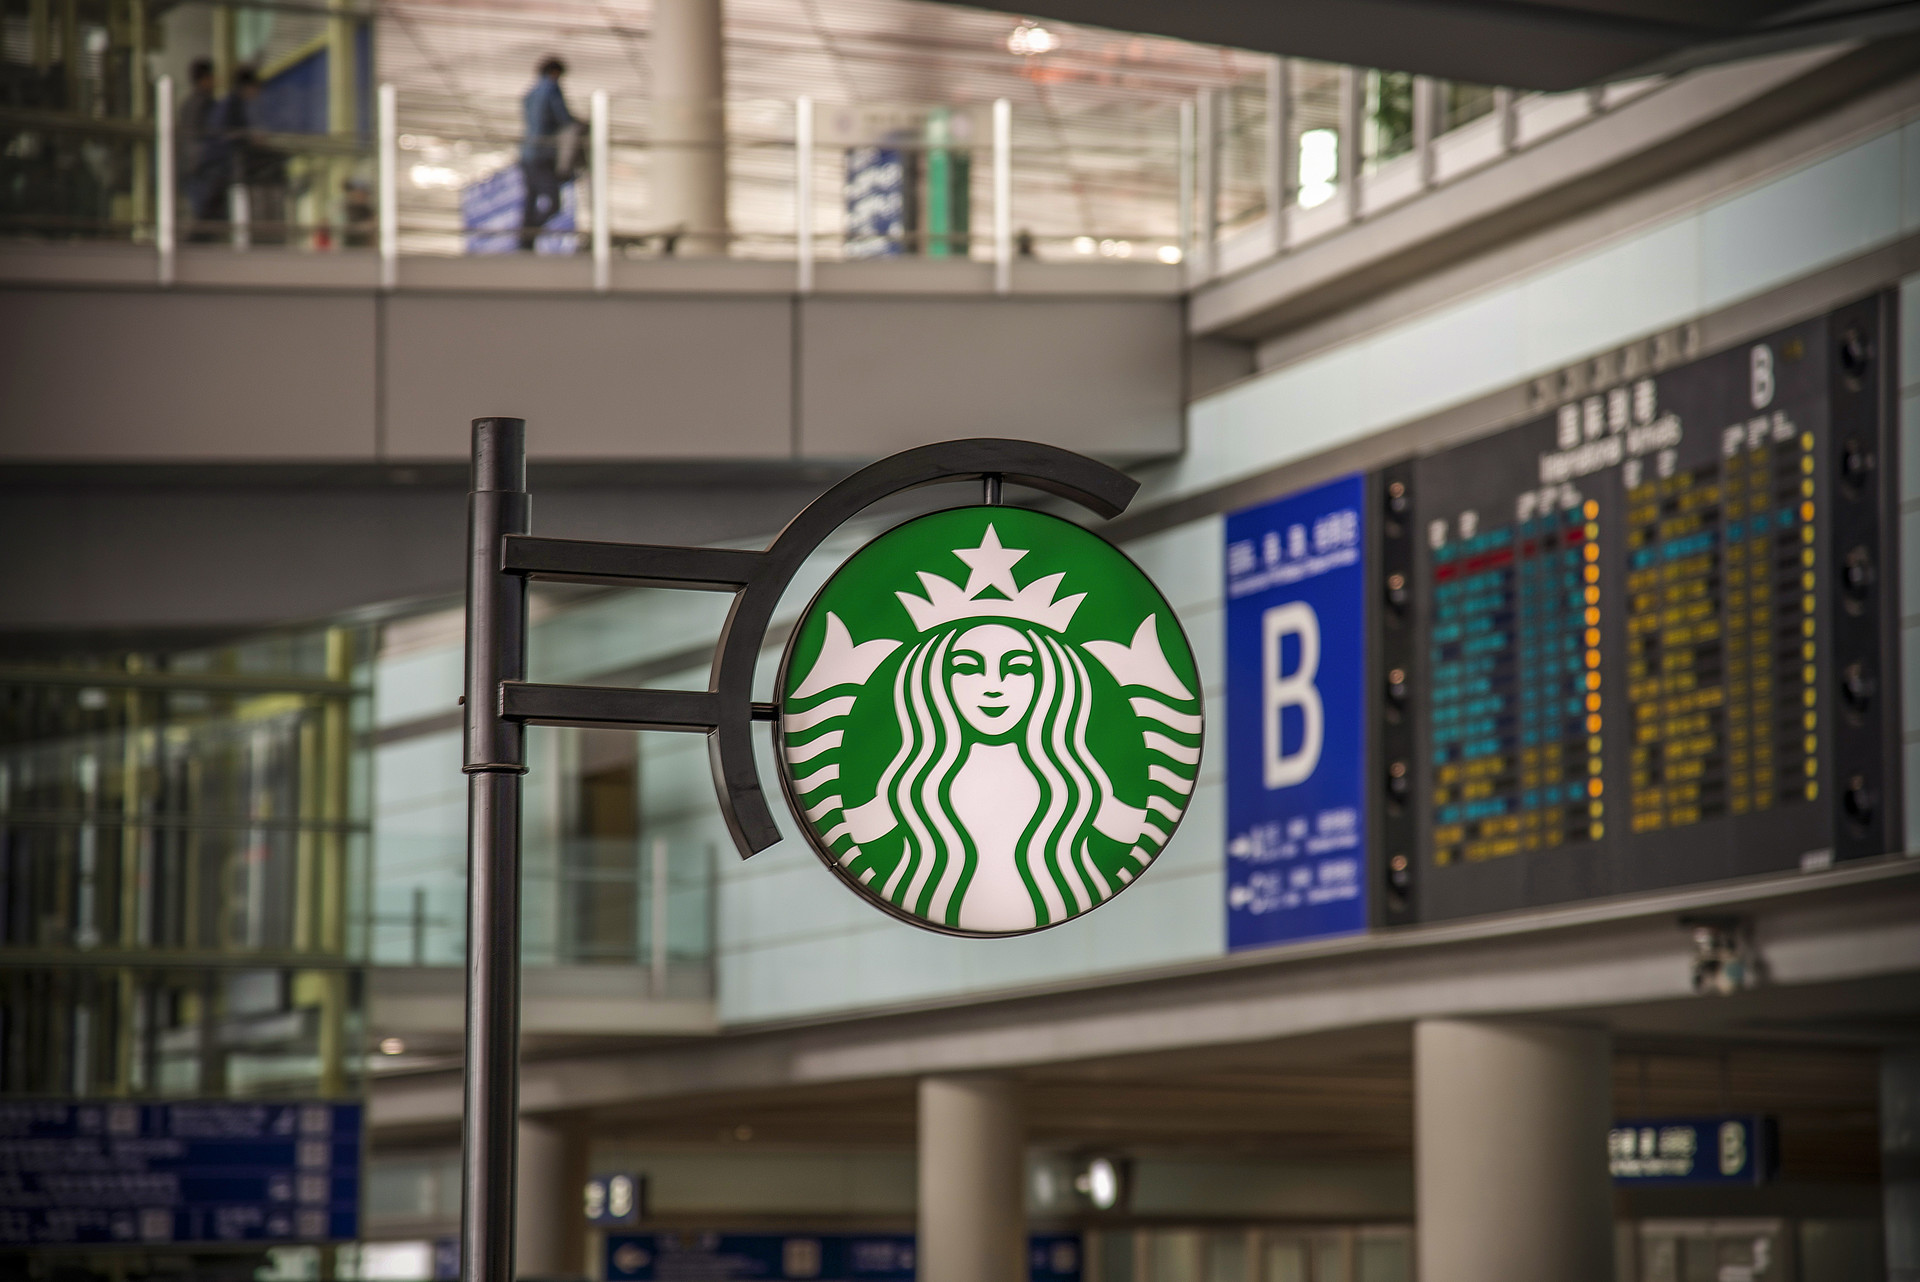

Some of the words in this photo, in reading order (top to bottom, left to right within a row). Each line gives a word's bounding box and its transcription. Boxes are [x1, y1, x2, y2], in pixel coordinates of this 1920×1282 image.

[1751, 344, 1774, 409] B
[1262, 600, 1325, 790] B
[1718, 1121, 1747, 1175] B
